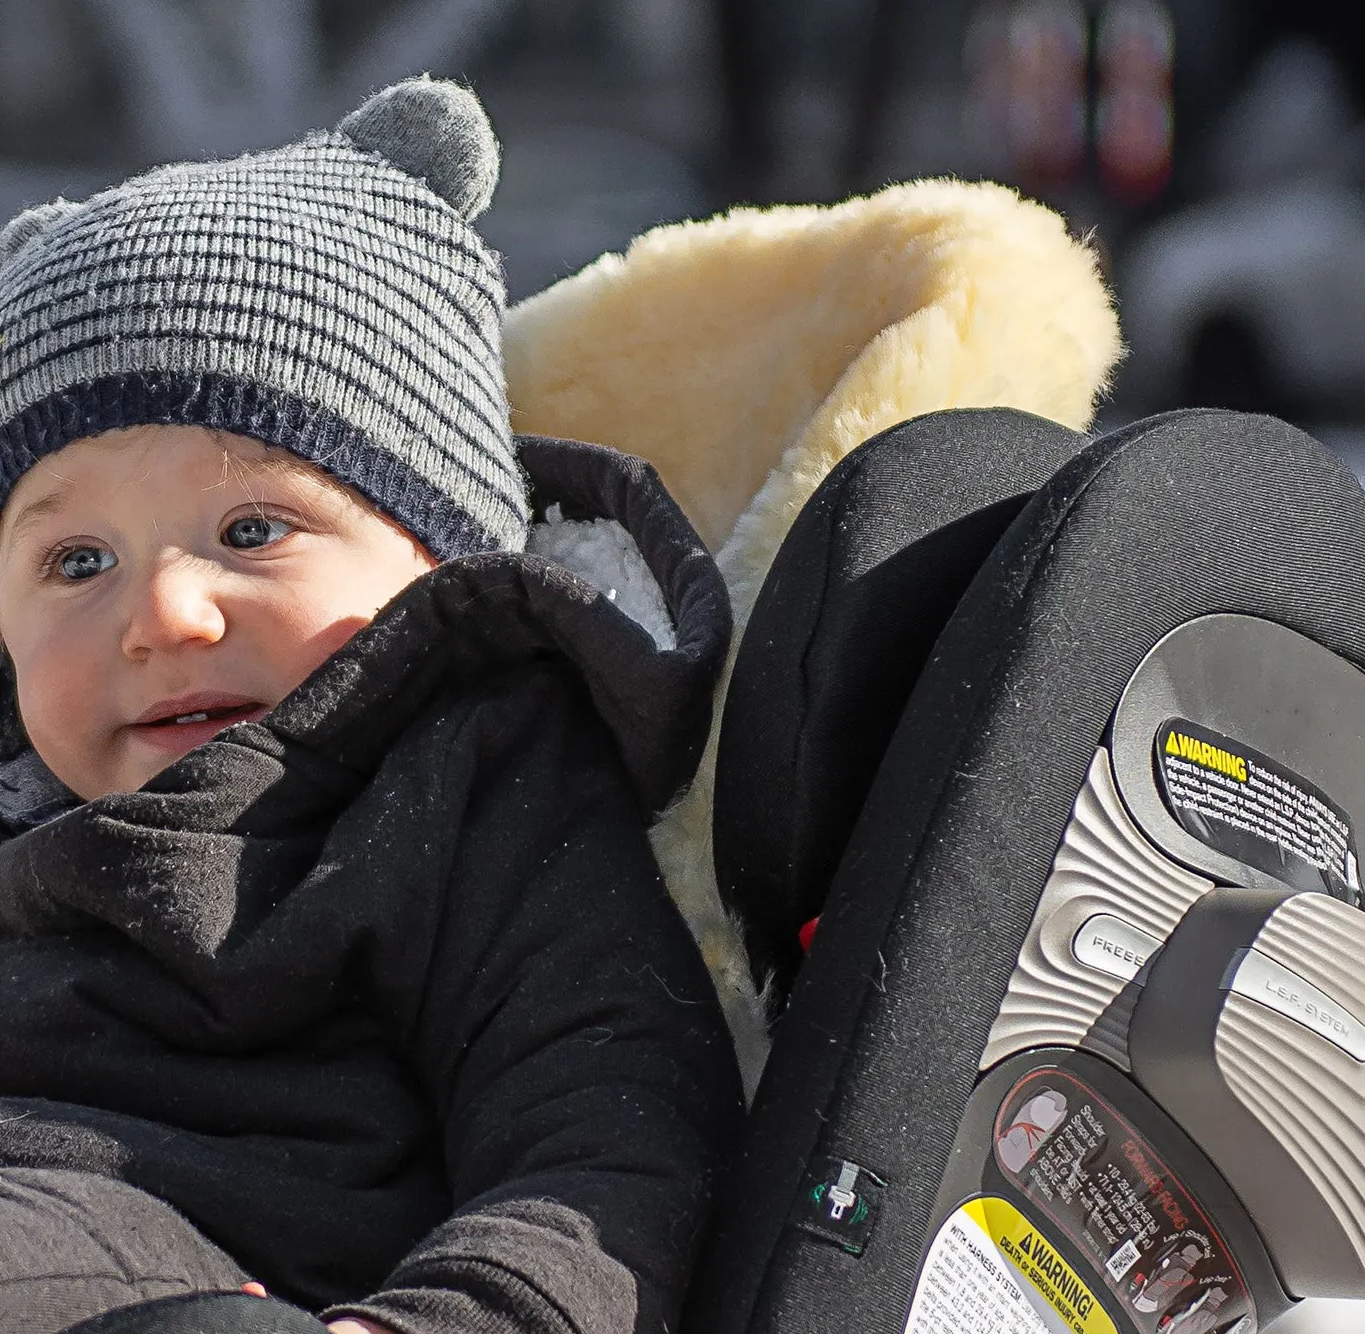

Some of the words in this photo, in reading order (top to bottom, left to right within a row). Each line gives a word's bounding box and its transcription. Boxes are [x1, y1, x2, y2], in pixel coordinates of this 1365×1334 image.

[1178, 733, 1246, 781] WARNING
[1302, 1001, 1352, 1037] SYSTEM
[948, 1222, 968, 1246] WITH
[964, 1239, 998, 1278] HARNESS
[998, 1235, 1024, 1265] DEATH
[1019, 1259, 1030, 1273] or
[1026, 1266, 1057, 1302] SERIOUS
[1051, 1295, 1076, 1325] INJURY
[1027, 1239, 1098, 1321] WARNING!
